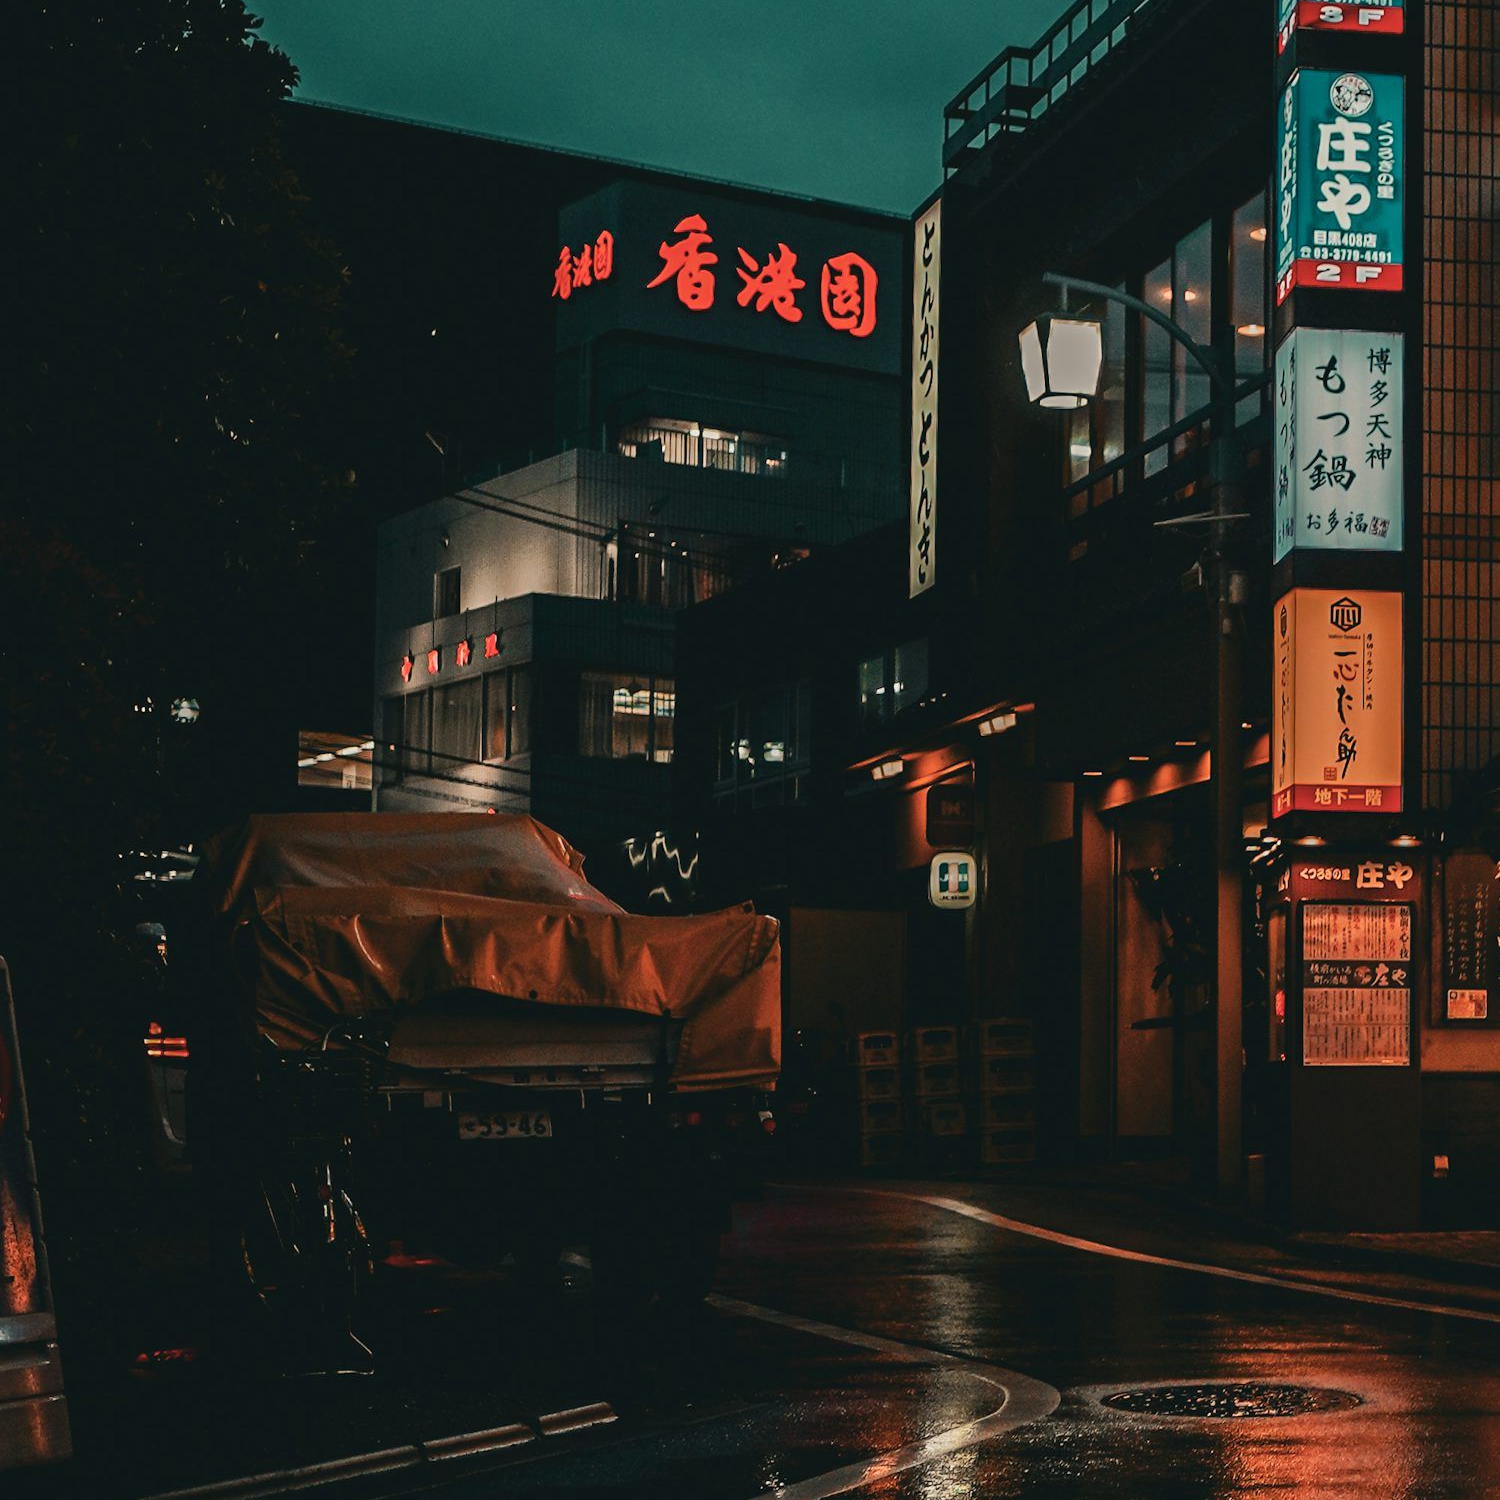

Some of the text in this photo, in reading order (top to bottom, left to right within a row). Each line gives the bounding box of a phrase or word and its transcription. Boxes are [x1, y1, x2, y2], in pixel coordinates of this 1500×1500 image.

[1316, 116, 1372, 230] 庄や
[647, 214, 878, 338] 香港園
[916, 222, 935, 585] とんかつ とんき
[1302, 355, 1357, 491] もつ鍋
[1365, 348, 1393, 470] 博多天神
[1306, 508, 1369, 536] お多福
[1314, 788, 1382, 807] 地下一階
[1356, 861, 1414, 890] 庄や
